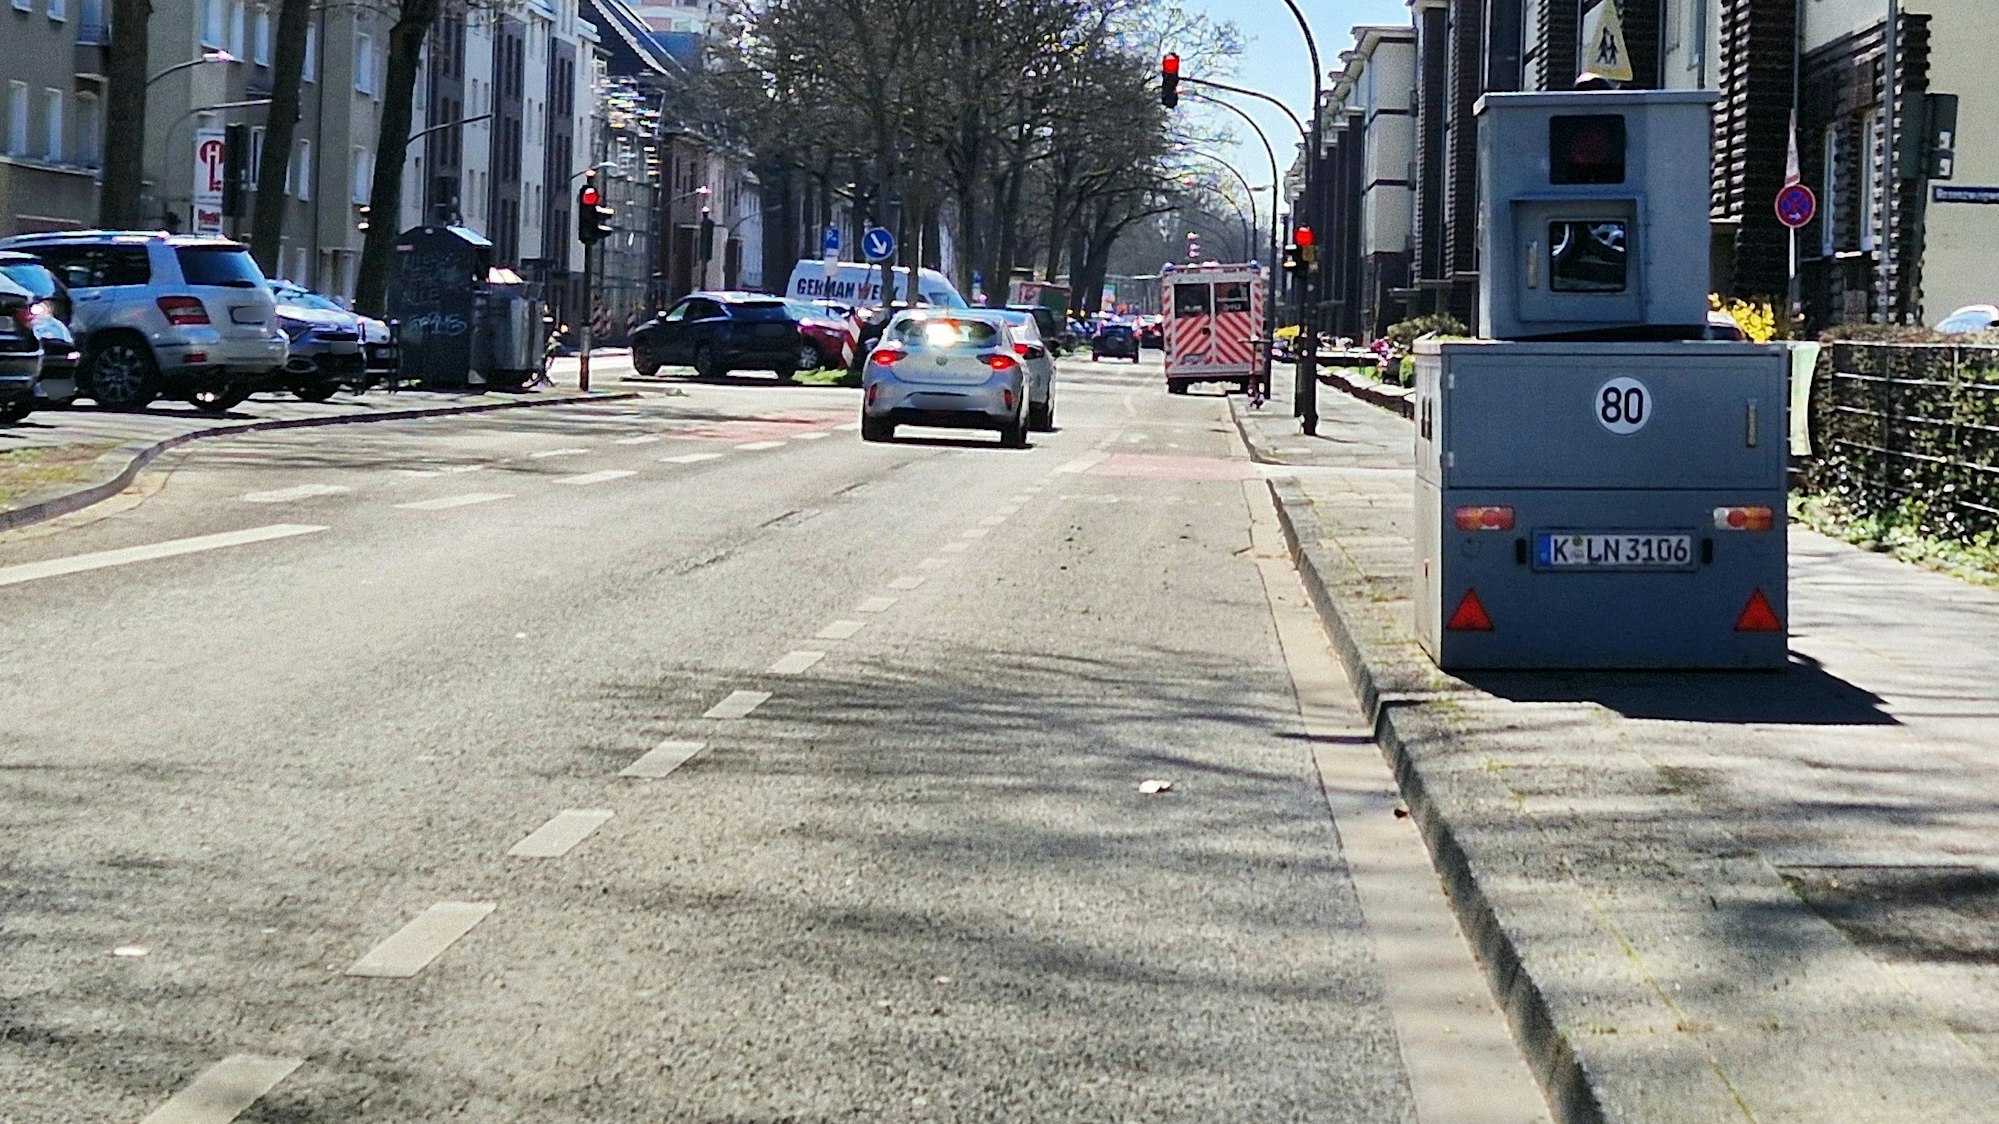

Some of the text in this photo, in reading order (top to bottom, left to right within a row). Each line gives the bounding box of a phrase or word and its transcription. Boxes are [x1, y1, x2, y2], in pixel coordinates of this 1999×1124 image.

[797, 278, 899, 301] GERMAN WE
[1602, 386, 1643, 424] 80
[1553, 538, 1569, 562] K
